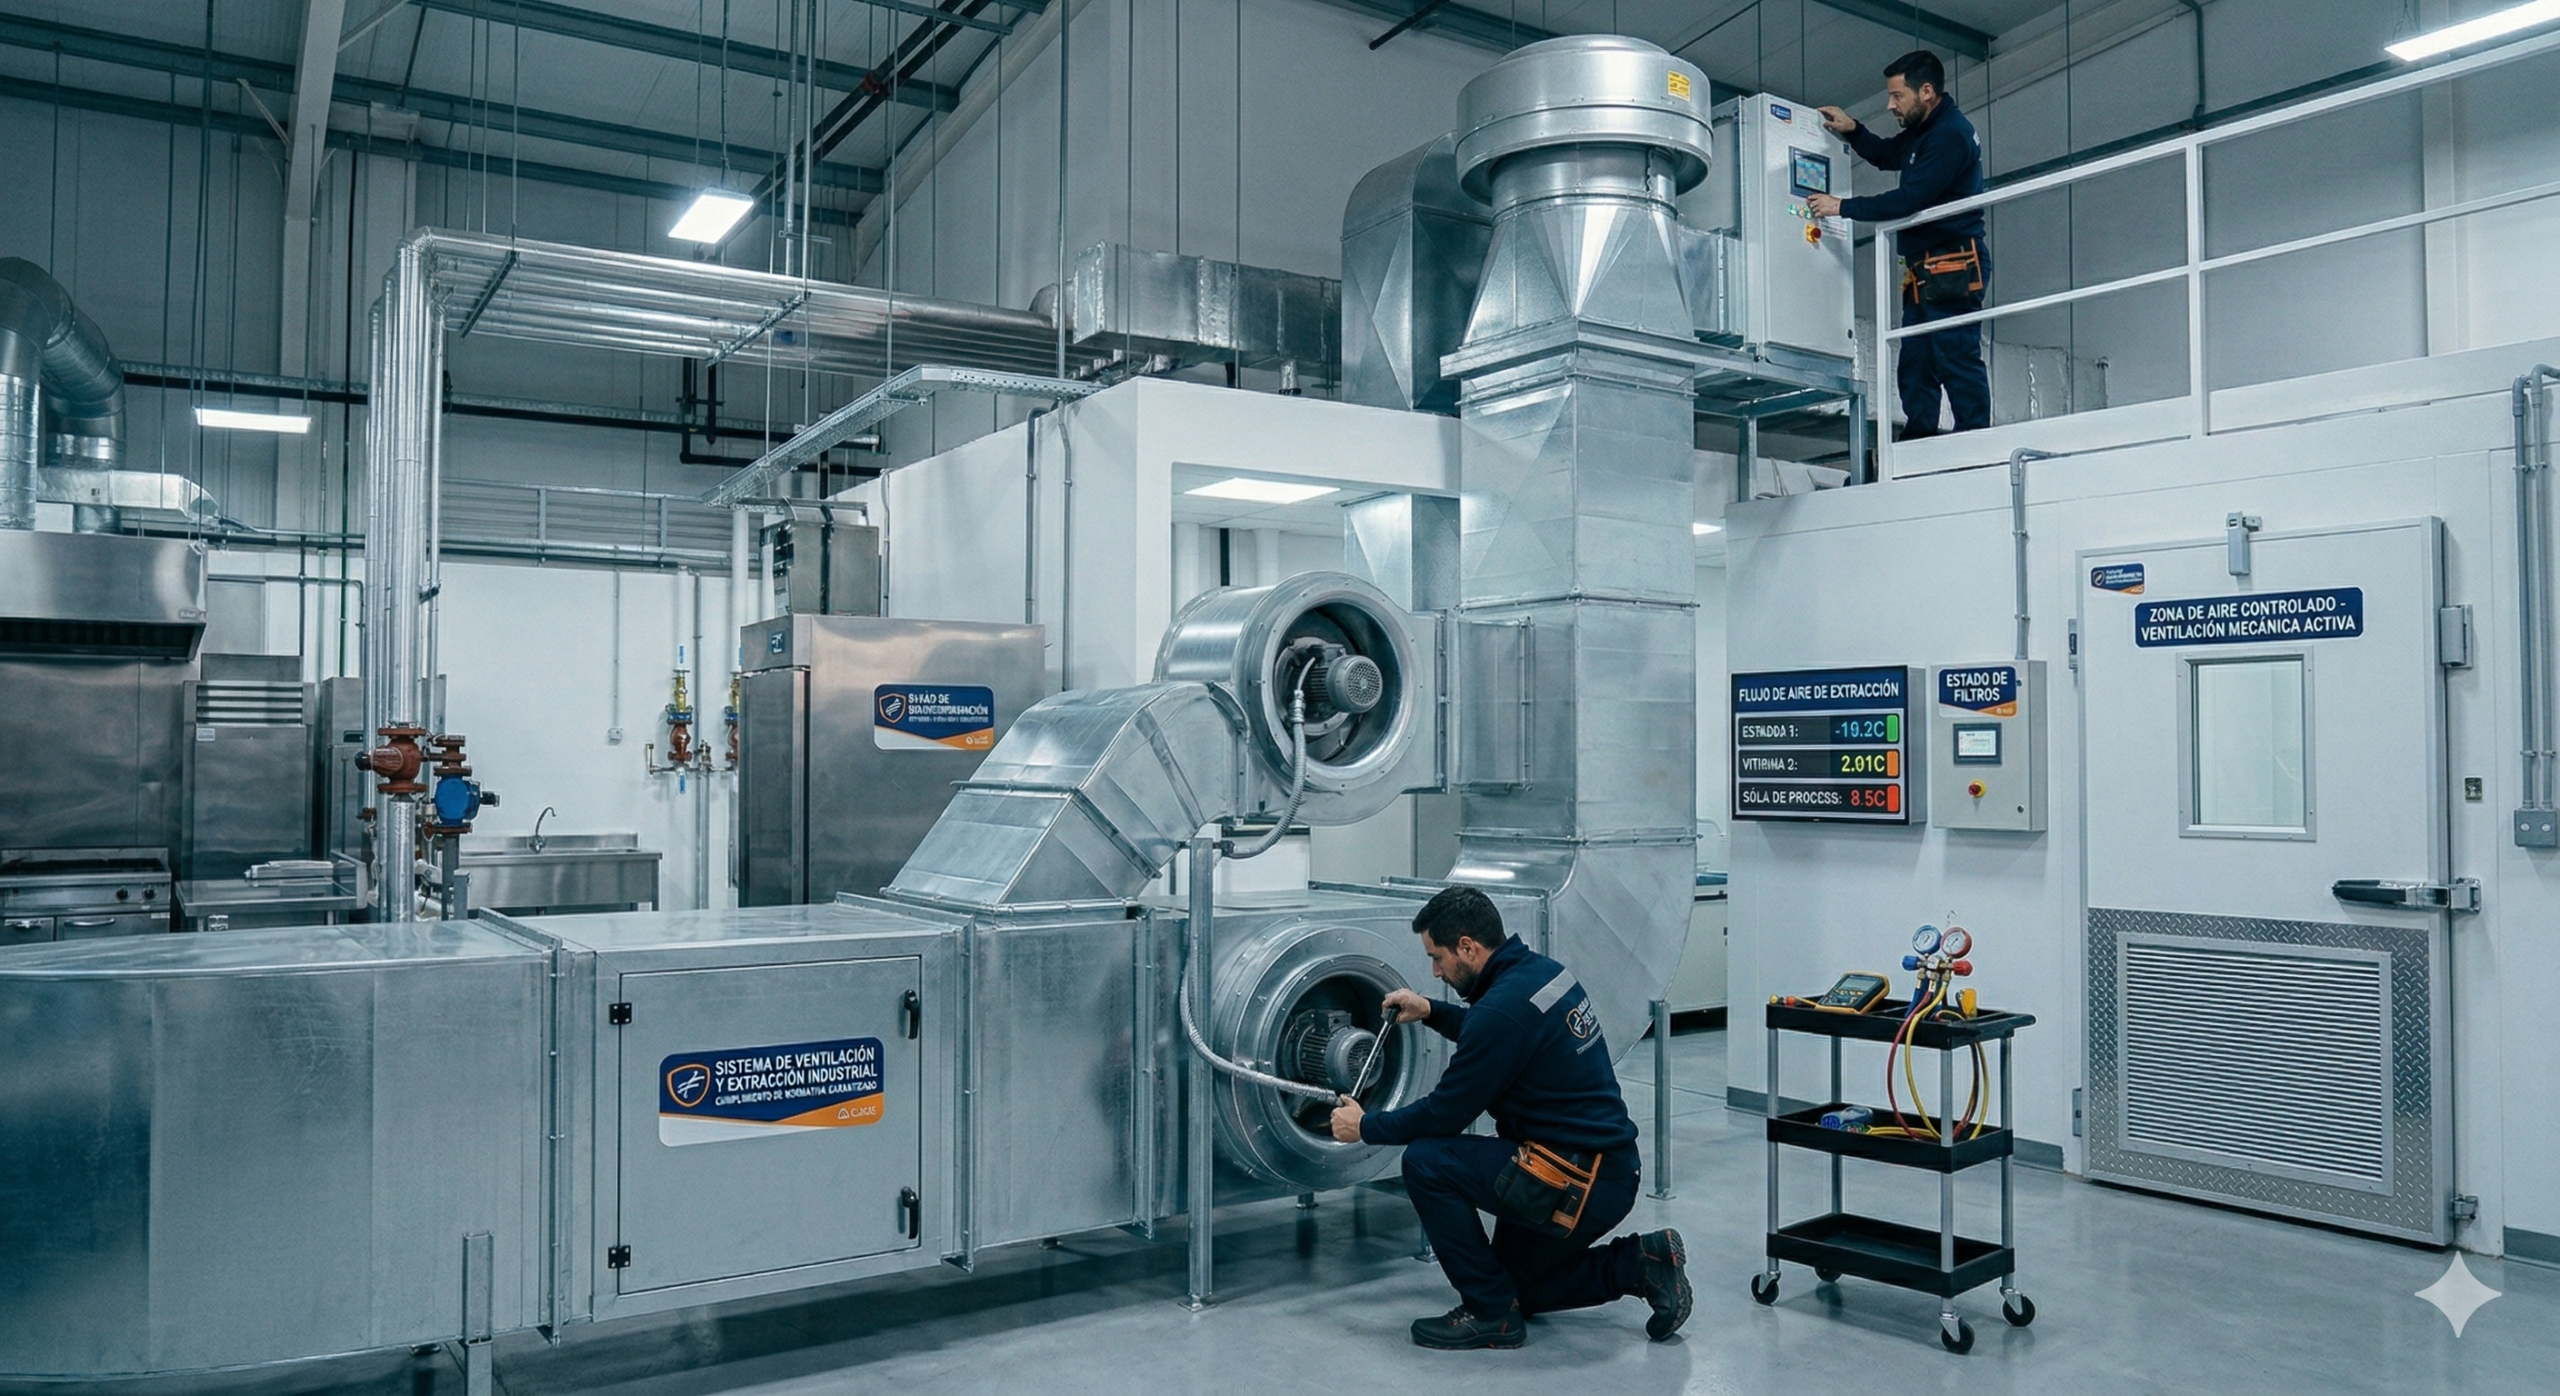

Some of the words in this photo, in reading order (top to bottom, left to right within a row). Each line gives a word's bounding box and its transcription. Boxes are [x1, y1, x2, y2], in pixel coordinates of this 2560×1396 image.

[2149, 606, 2184, 623] ZONA
[2188, 605, 2205, 620] DE
[2207, 603, 2238, 619] AIRE
[2240, 596, 2336, 617] CONTROLADO
[2141, 619, 2225, 641] VENTILACIÓN
[2229, 617, 2300, 636] MECÁNICA
[2303, 614, 2356, 633] ACTIVA
[1739, 687, 1770, 702] FLUJO
[1772, 686, 1786, 700] DE
[1787, 685, 1812, 700] AIRE
[1814, 684, 1828, 699] DE
[1830, 678, 1899, 699] EXTRACCIÓN
[1946, 672, 1990, 687] ESTADO
[1992, 671, 2008, 686] DE
[1954, 687, 2000, 702] FILTROS
[1772, 790, 1787, 803] DE
[1850, 789, 1886, 807] 8.5C
[715, 1057, 773, 1075] SISTEMA
[776, 1054, 792, 1071] DE
[795, 1045, 875, 1069] VENTILACIÓN
[715, 1077, 725, 1092] Y
[727, 1068, 807, 1092] EXTRACCIÓN
[808, 1063, 877, 1084] INDUSTRIAL
